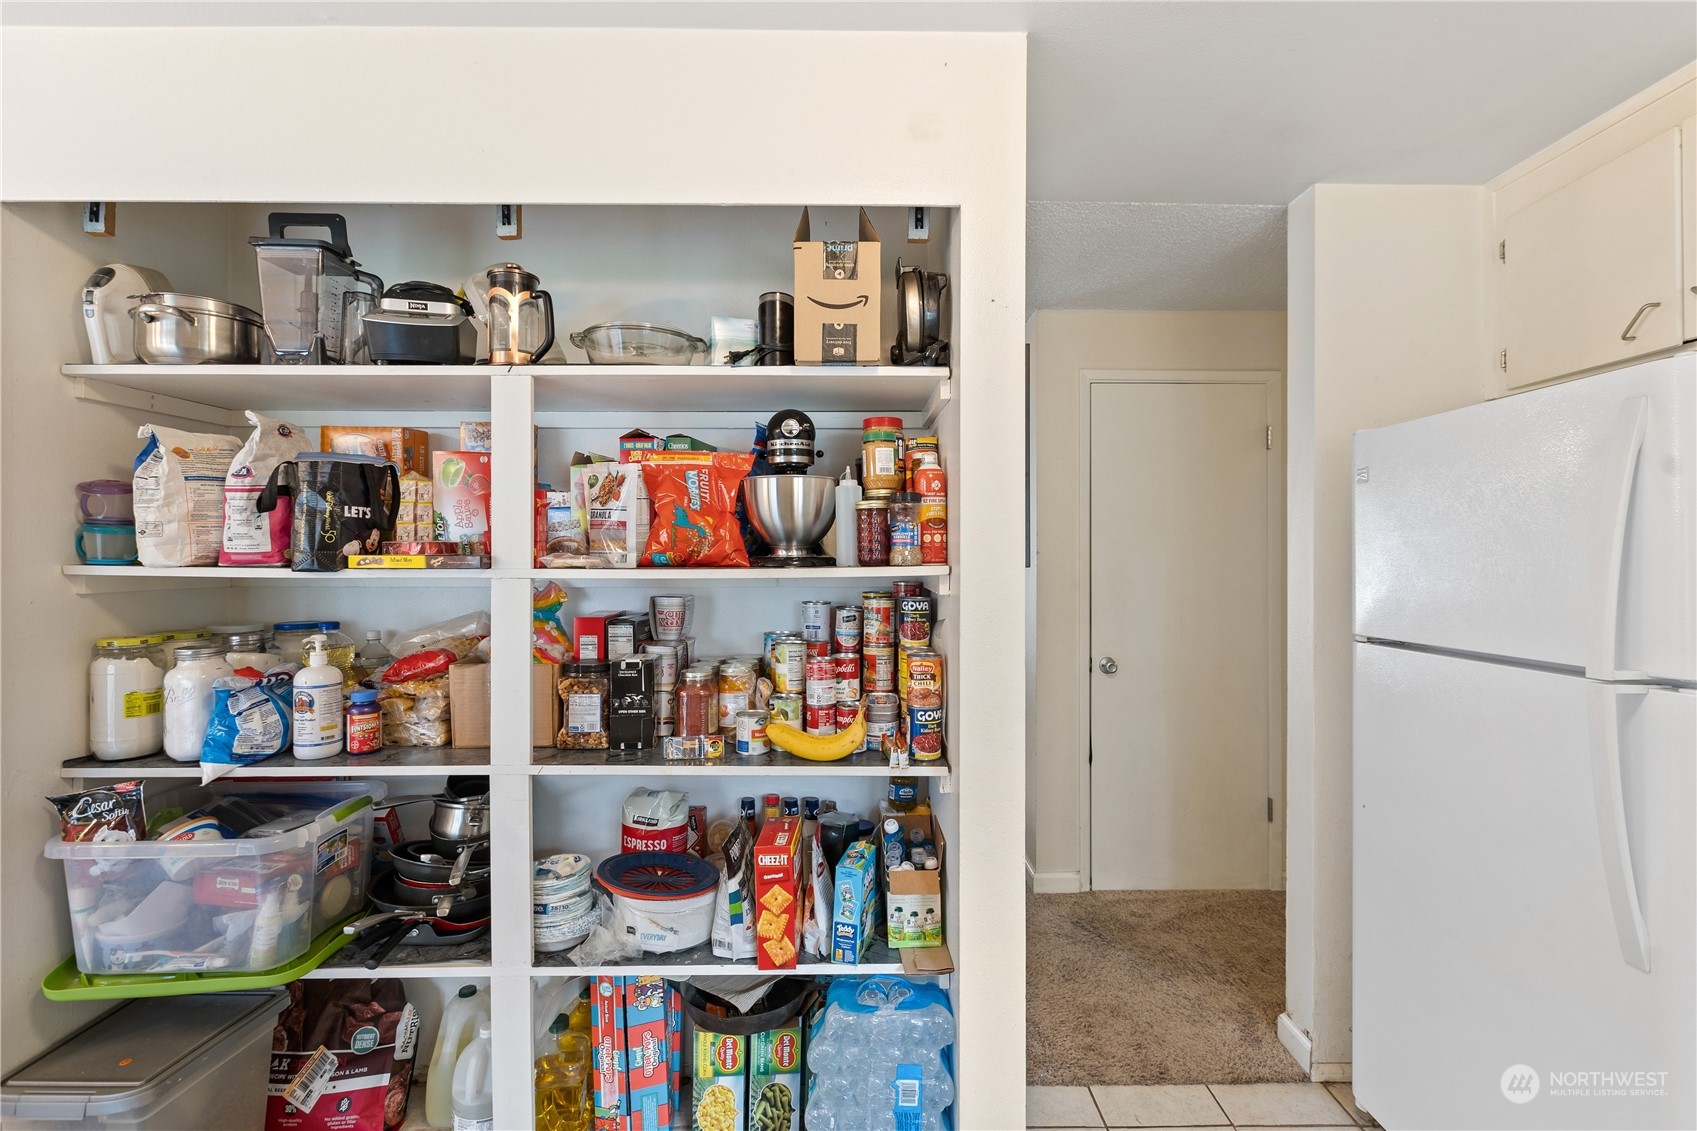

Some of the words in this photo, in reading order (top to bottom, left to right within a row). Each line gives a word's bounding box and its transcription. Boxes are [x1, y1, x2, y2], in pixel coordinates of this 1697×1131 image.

[826, 243, 853, 253] prime
[667, 442, 689, 450] Cheerios
[700, 469, 712, 504] FRUITY
[344, 505, 371, 519] LET'S
[454, 499, 463, 529] Apple
[464, 499, 474, 528] Sauce
[435, 518, 446, 533] TOP
[902, 601, 929, 611] GOYA
[664, 610, 686, 620] CUP
[658, 618, 686, 628] NOODL
[911, 665, 933, 673] Nalley
[72, 796, 116, 817] Cesar
[623, 834, 667, 850] ESPRESSO
[836, 924, 855, 934] Teddy
[640, 932, 667, 942] EVERYDAY
[354, 1039, 375, 1049] DENSE
[726, 1038, 734, 1048] Del
[598, 1043, 606, 1074] Original
[651, 1038, 660, 1067] Original
[726, 1049, 734, 1069] Monte
[782, 1046, 790, 1067] Monte
[271, 1058, 291, 1071] AK
[351, 1066, 368, 1074] LAMB
